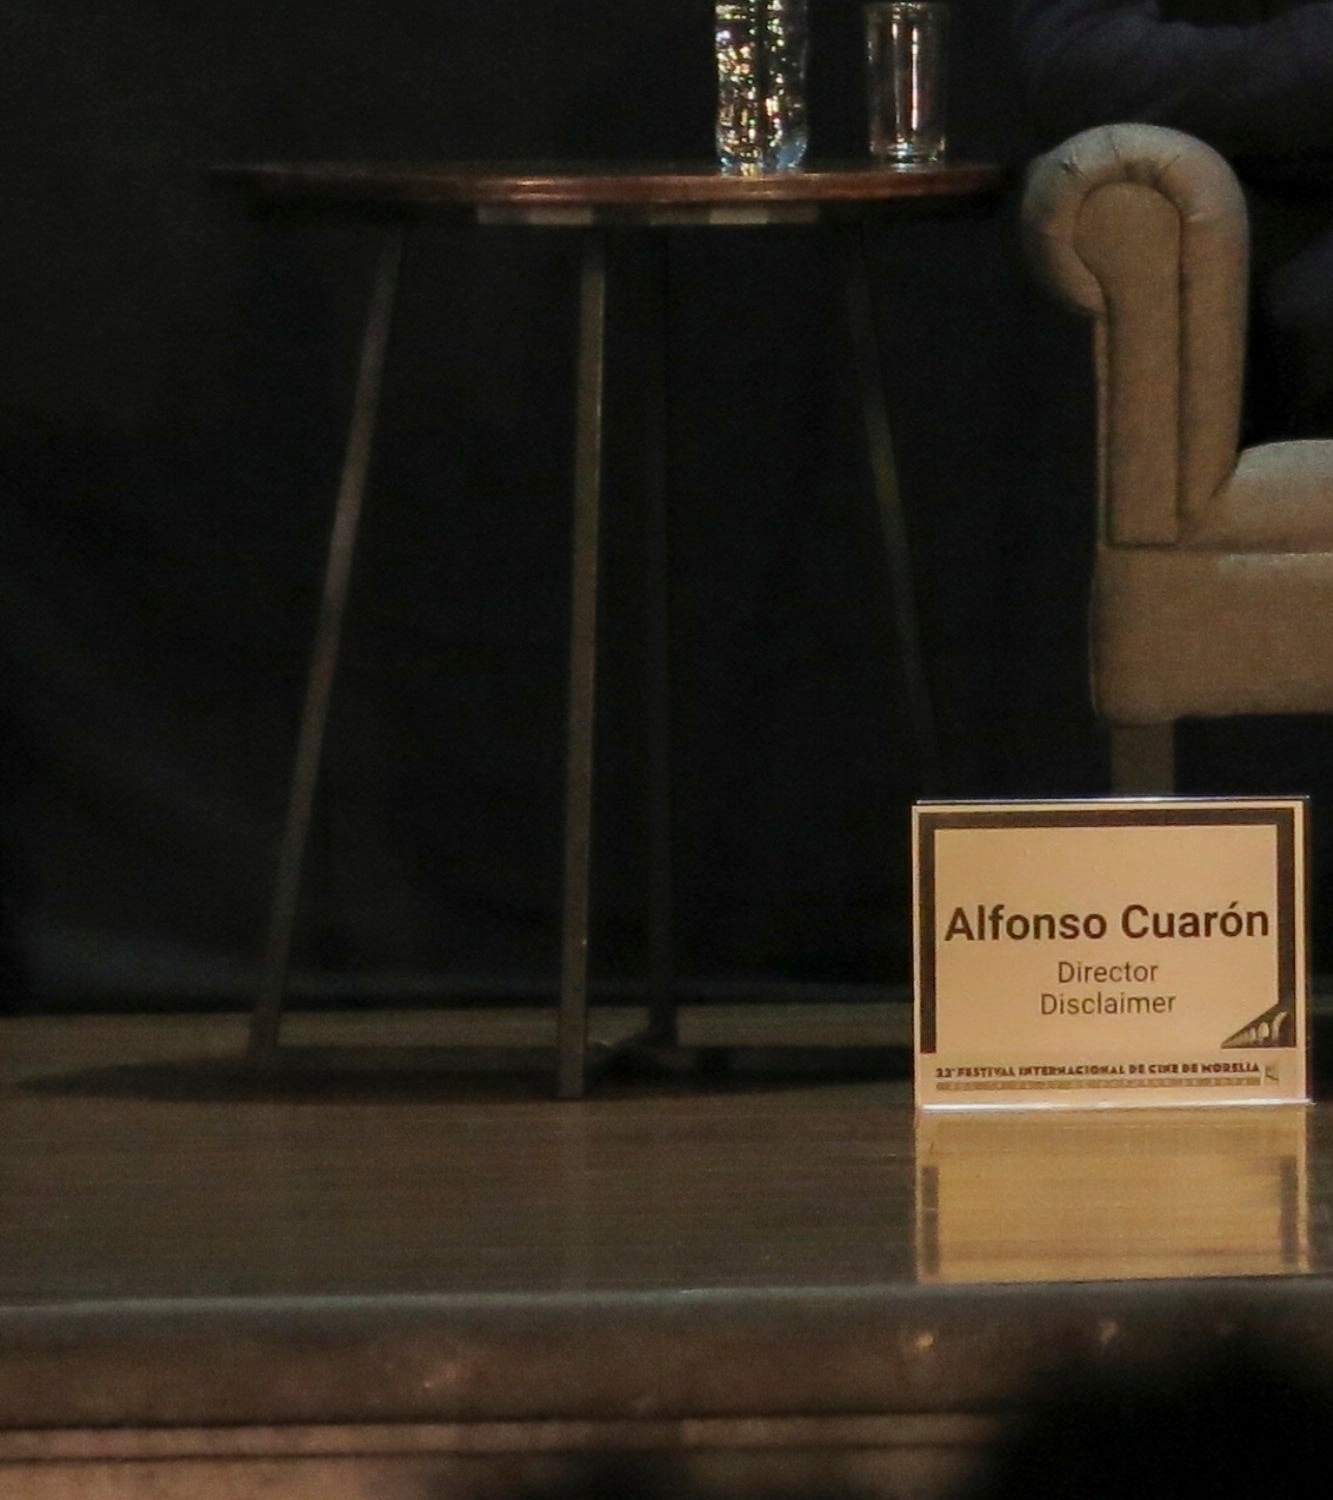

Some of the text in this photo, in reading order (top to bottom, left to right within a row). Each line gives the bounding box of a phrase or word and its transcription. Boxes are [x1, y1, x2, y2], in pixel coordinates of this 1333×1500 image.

[944, 901, 1269, 942] Alfonso Cuarón
[1058, 960, 1159, 984] Director
[1040, 991, 1177, 1016] Disclaimer
[957, 1067, 1015, 1078] FESTIVAL
[1019, 1064, 1125, 1076] INTERNACIONAL
